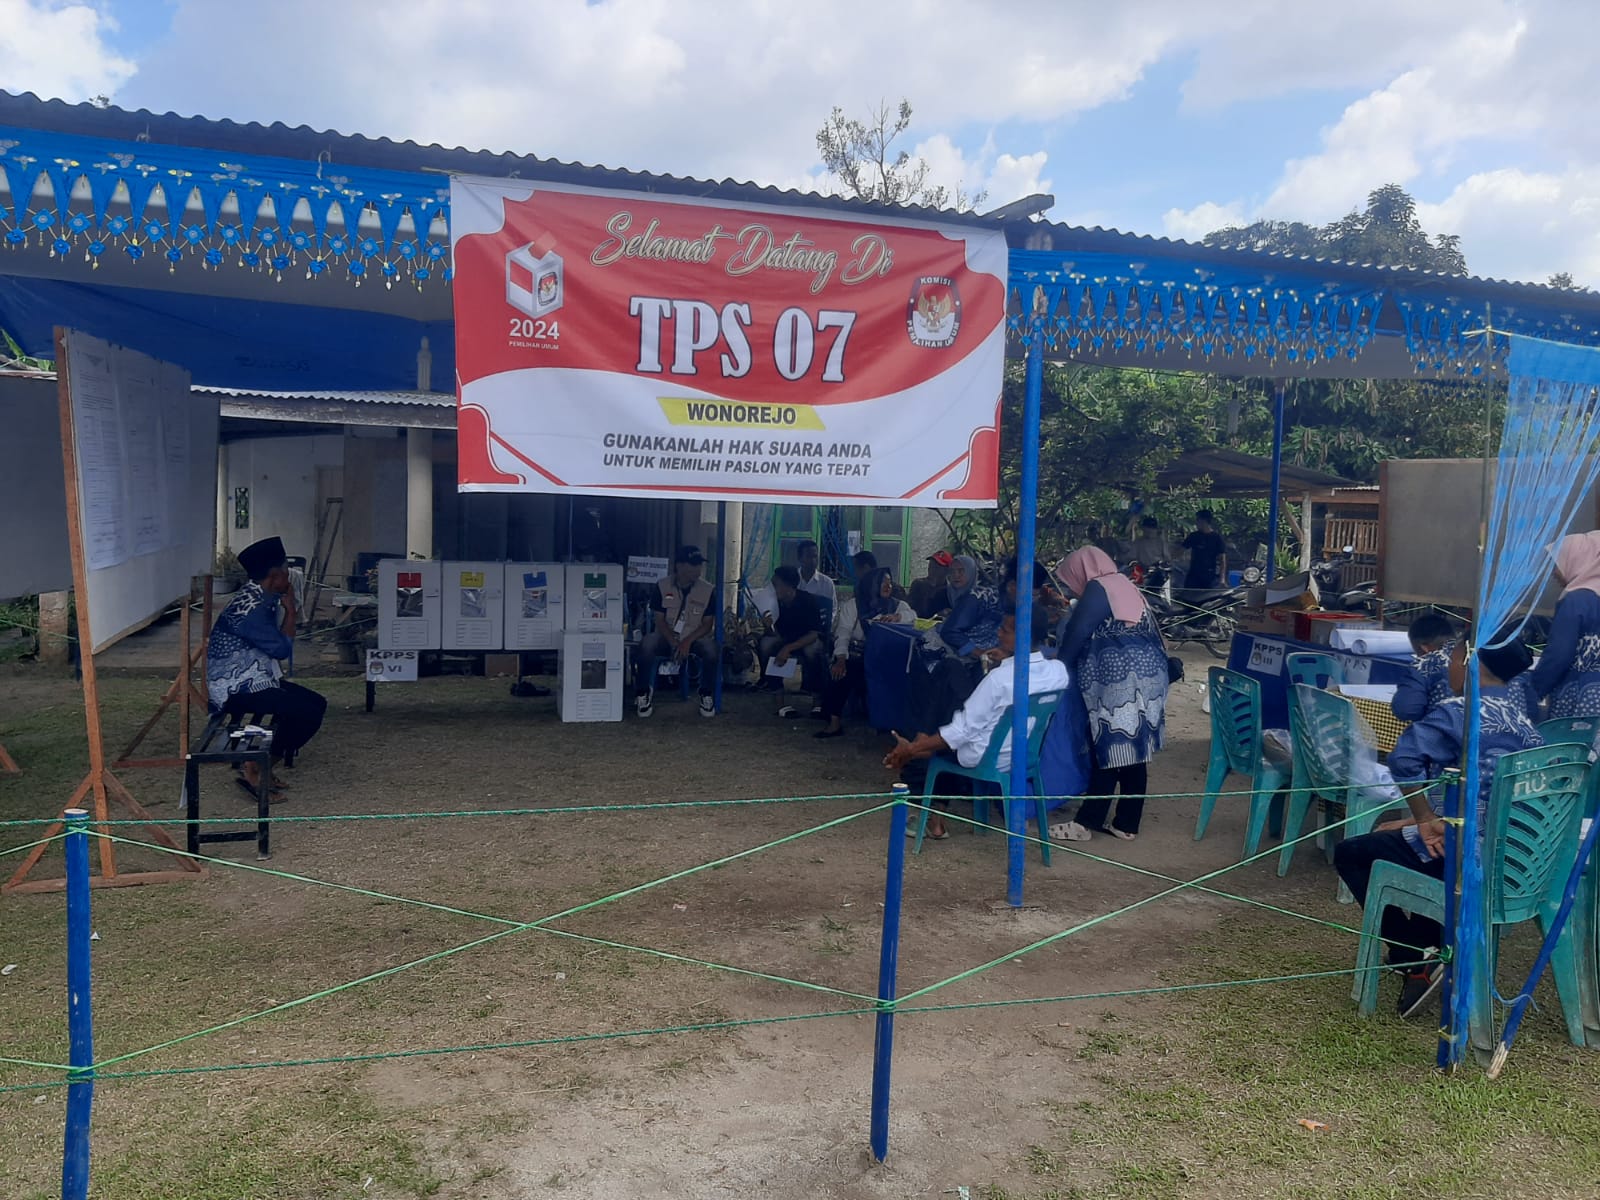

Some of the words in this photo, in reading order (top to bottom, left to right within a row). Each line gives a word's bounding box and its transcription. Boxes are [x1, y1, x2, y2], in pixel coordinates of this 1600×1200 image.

[590, 211, 735, 267] Selamat
[725, 223, 838, 295] Datang
[840, 233, 895, 285] Di
[920, 276, 951, 286] KOMISI
[509, 318, 560, 340] 2024
[629, 295, 752, 379] TPS
[773, 307, 857, 383] 07
[686, 402, 797, 425] WONOREJO
[603, 433, 724, 455] GUNAKANLAH
[728, 439, 764, 456] HAK
[768, 441, 823, 458] SUARA
[827, 443, 872, 459] ANDA
[603, 453, 656, 469] UNTUK
[658, 456, 721, 472] MEMILIH
[724, 459, 783, 475] PASLON
[785, 461, 823, 476] YANG
[826, 463, 871, 477] TEPAT
[370, 650, 417, 659] KPPS
[1254, 642, 1282, 656] KPPS
[387, 665, 402, 673] VI
